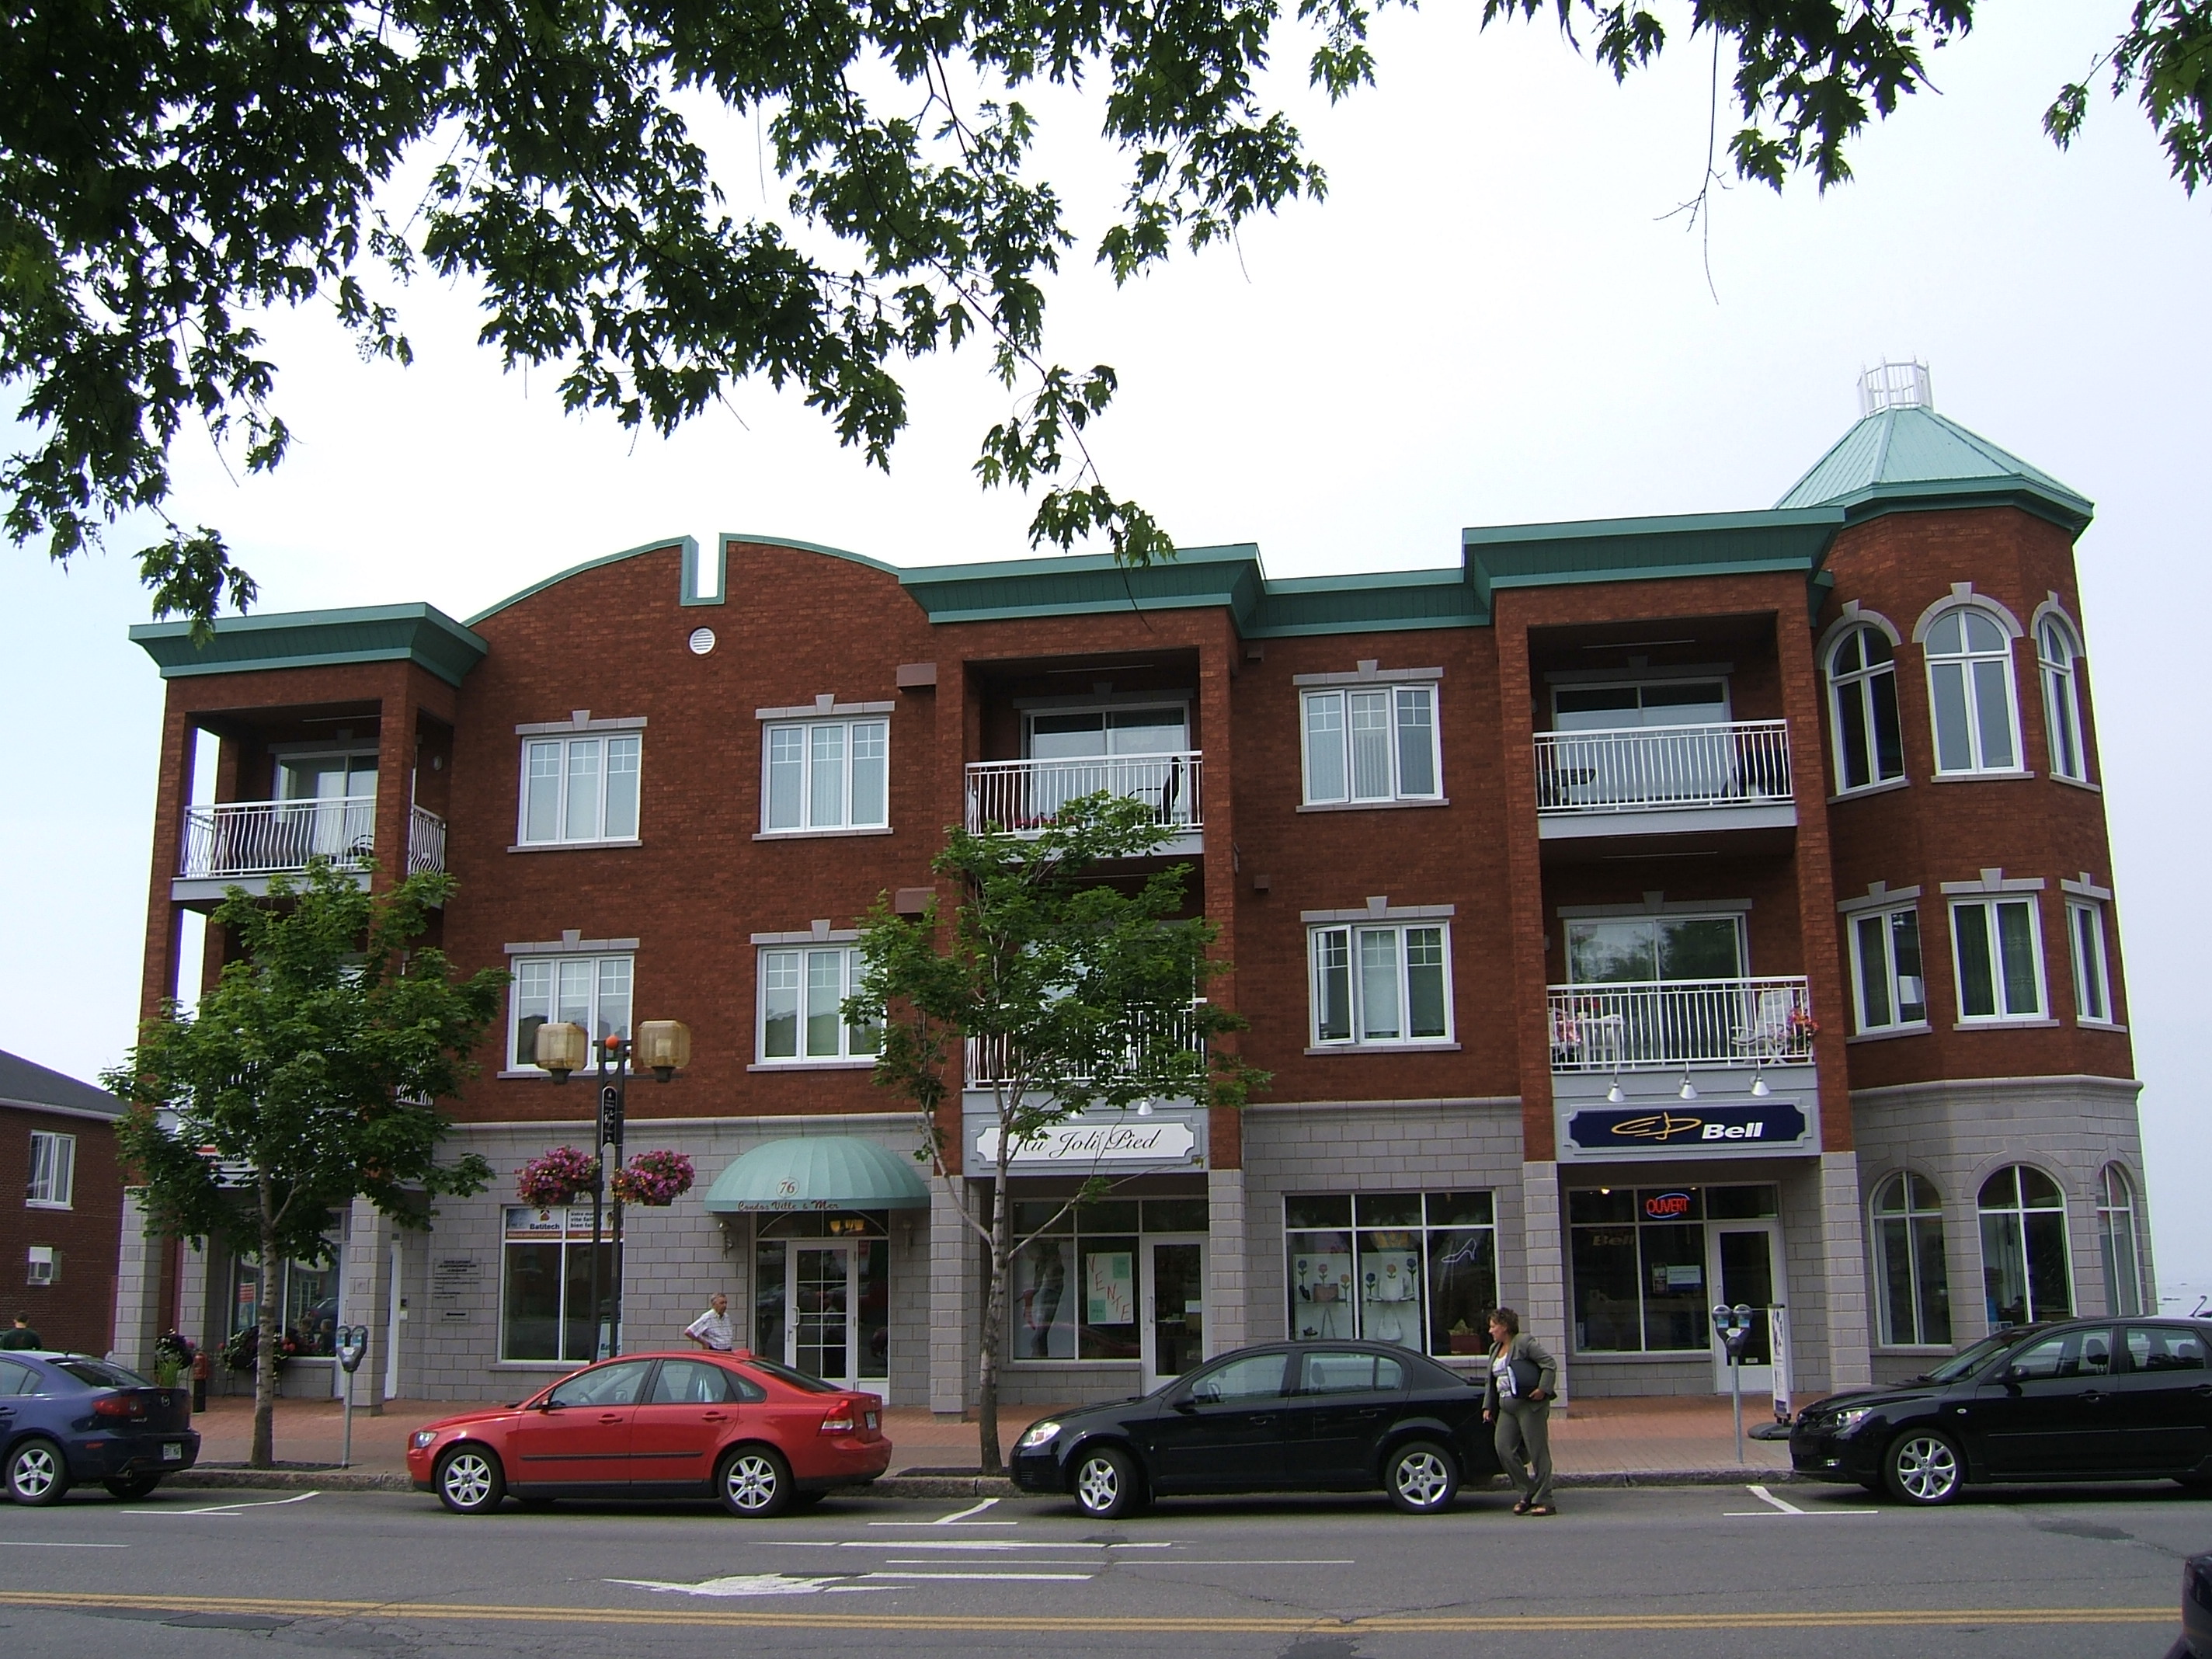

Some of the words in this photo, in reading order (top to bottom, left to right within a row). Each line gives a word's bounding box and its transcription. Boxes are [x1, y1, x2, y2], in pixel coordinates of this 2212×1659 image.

[1702, 1122, 1763, 1139] Bell
[1049, 1131, 1102, 1158] Joli
[1105, 1129, 1161, 1150] Pied
[779, 1181, 795, 1194] 76
[738, 1201, 769, 1211] Condos
[771, 1201, 798, 1210] Ville
[811, 1200, 840, 1209] Mer
[1646, 1198, 1688, 1213] OUVERT
[1593, 1234, 1635, 1247] Bell
[1088, 1254, 1131, 1322] VENTE
